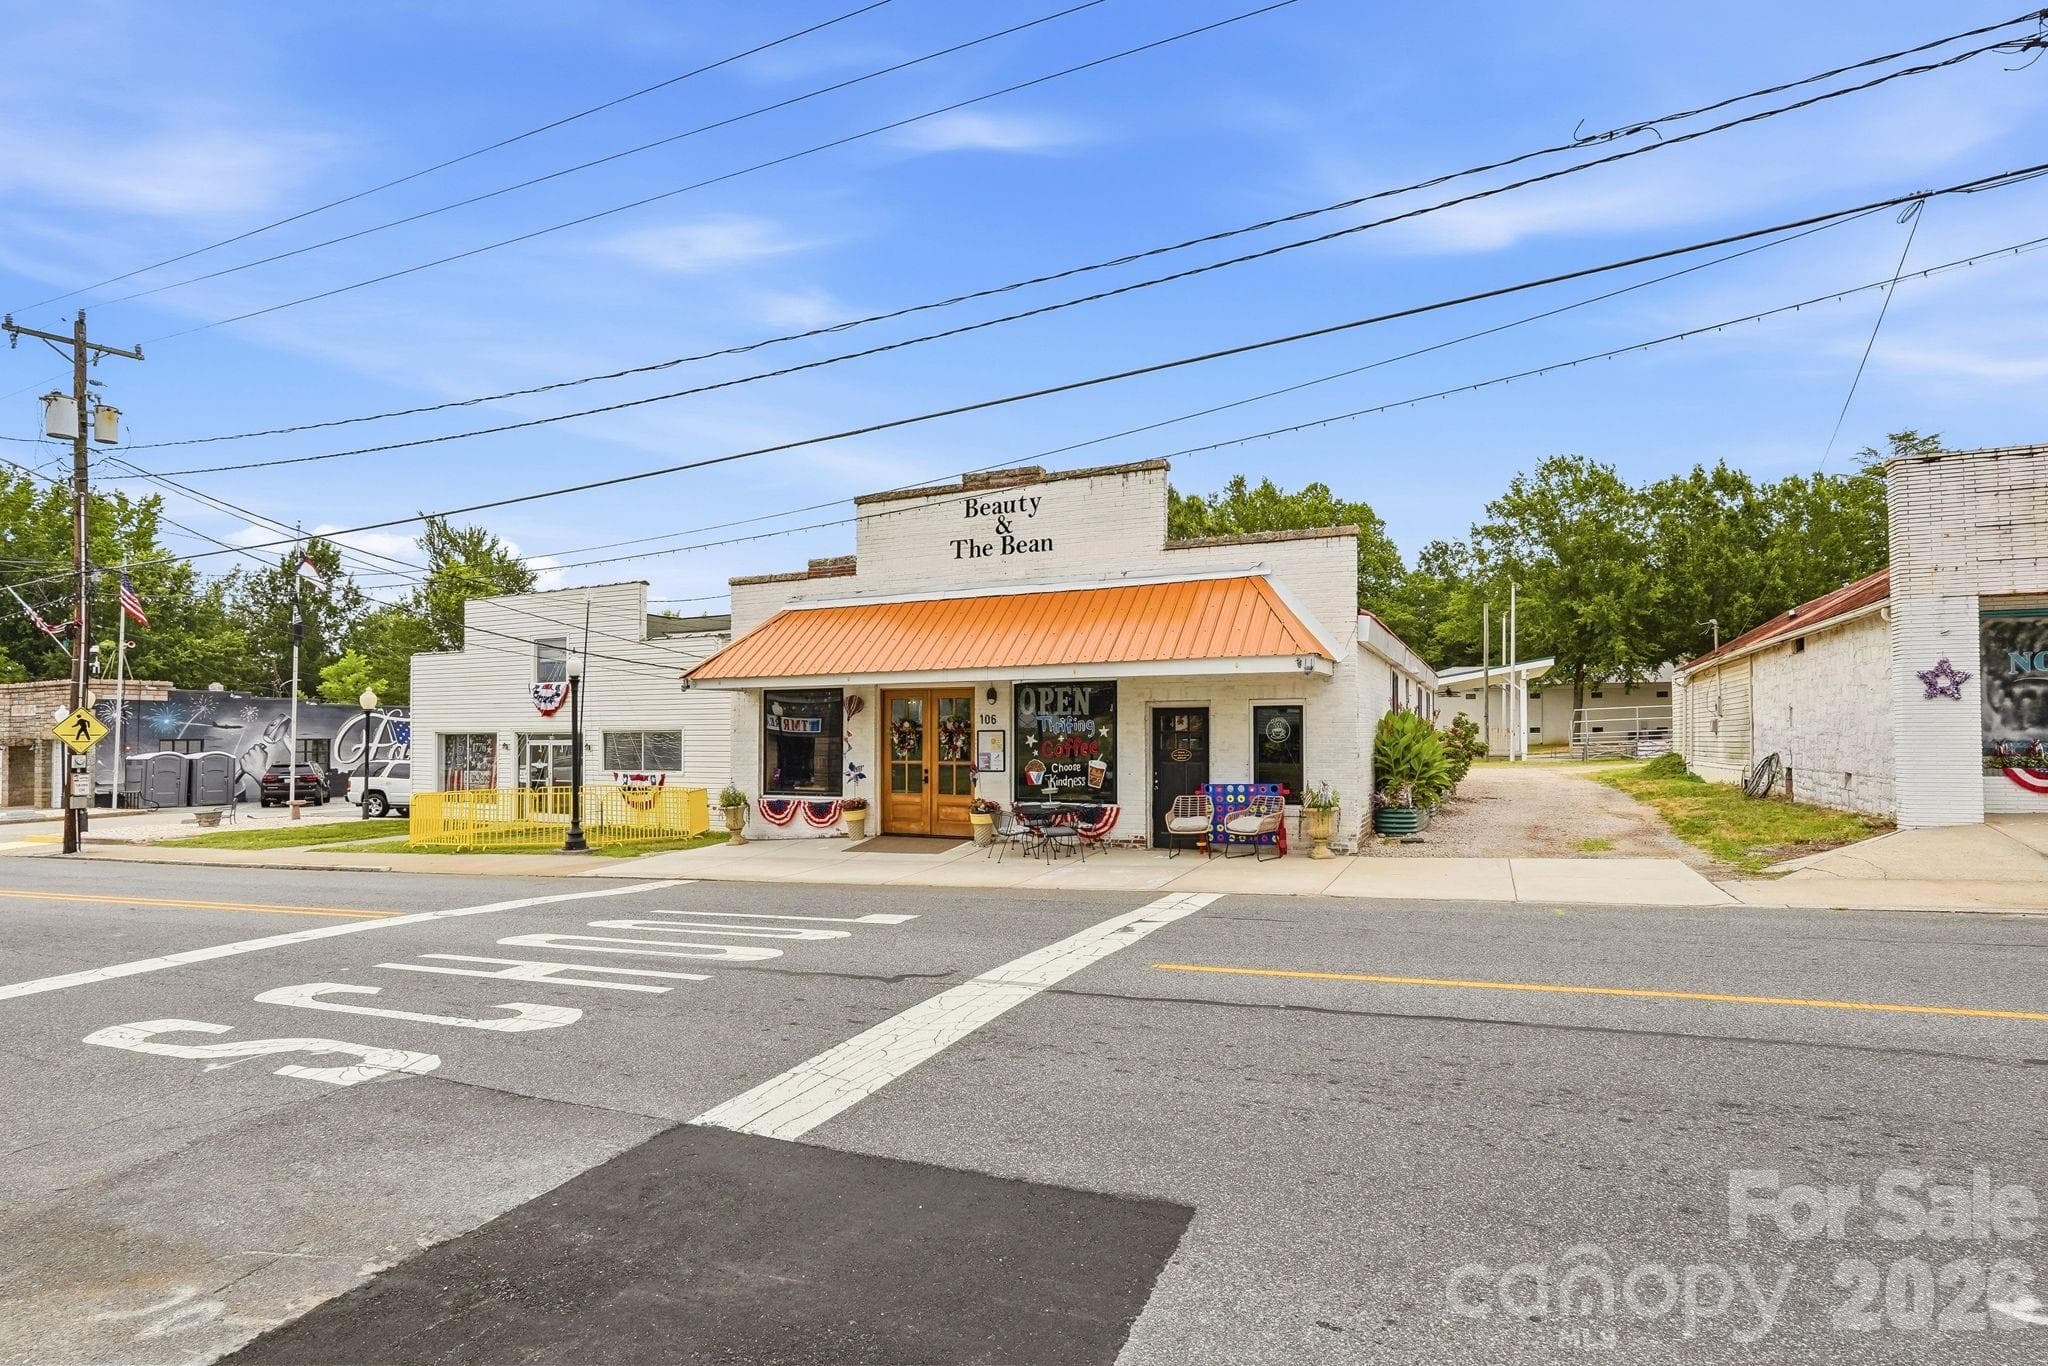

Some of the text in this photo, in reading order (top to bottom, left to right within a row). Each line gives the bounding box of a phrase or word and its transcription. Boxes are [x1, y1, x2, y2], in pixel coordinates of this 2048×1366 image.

[964, 495, 1042, 518] Beauty
[995, 515, 1013, 534] &
[949, 535, 1053, 559] The Bean
[1019, 687, 1092, 716] OPEN
[980, 714, 997, 725] 106
[1041, 736, 1099, 758] Coffee
[1051, 763, 1081, 773] Choose
[1046, 774, 1087, 788] Kindness
[81, 908, 922, 1087] SCHOOL
